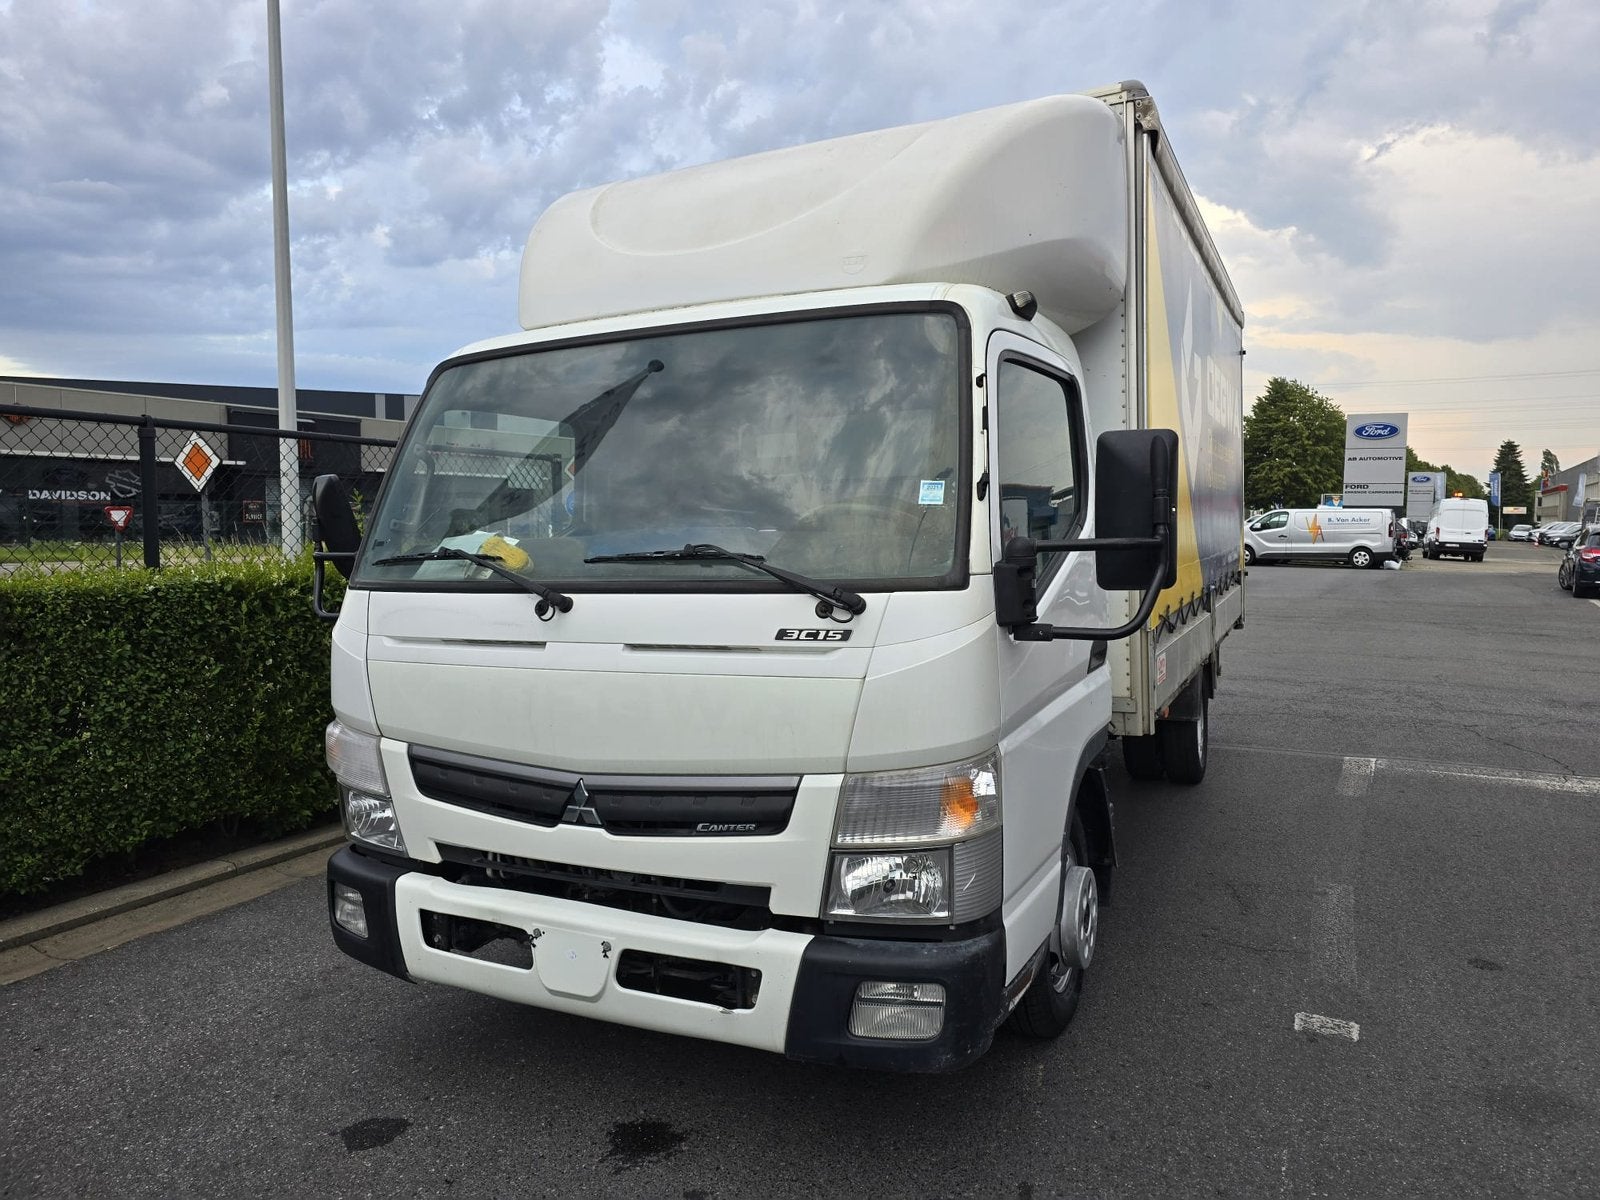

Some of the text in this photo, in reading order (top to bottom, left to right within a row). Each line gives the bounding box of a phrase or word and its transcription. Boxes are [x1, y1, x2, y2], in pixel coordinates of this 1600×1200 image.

[1362, 425, 1391, 437] Ford
[28, 489, 111, 501] DAVIDSON
[782, 629, 844, 641] 3C15
